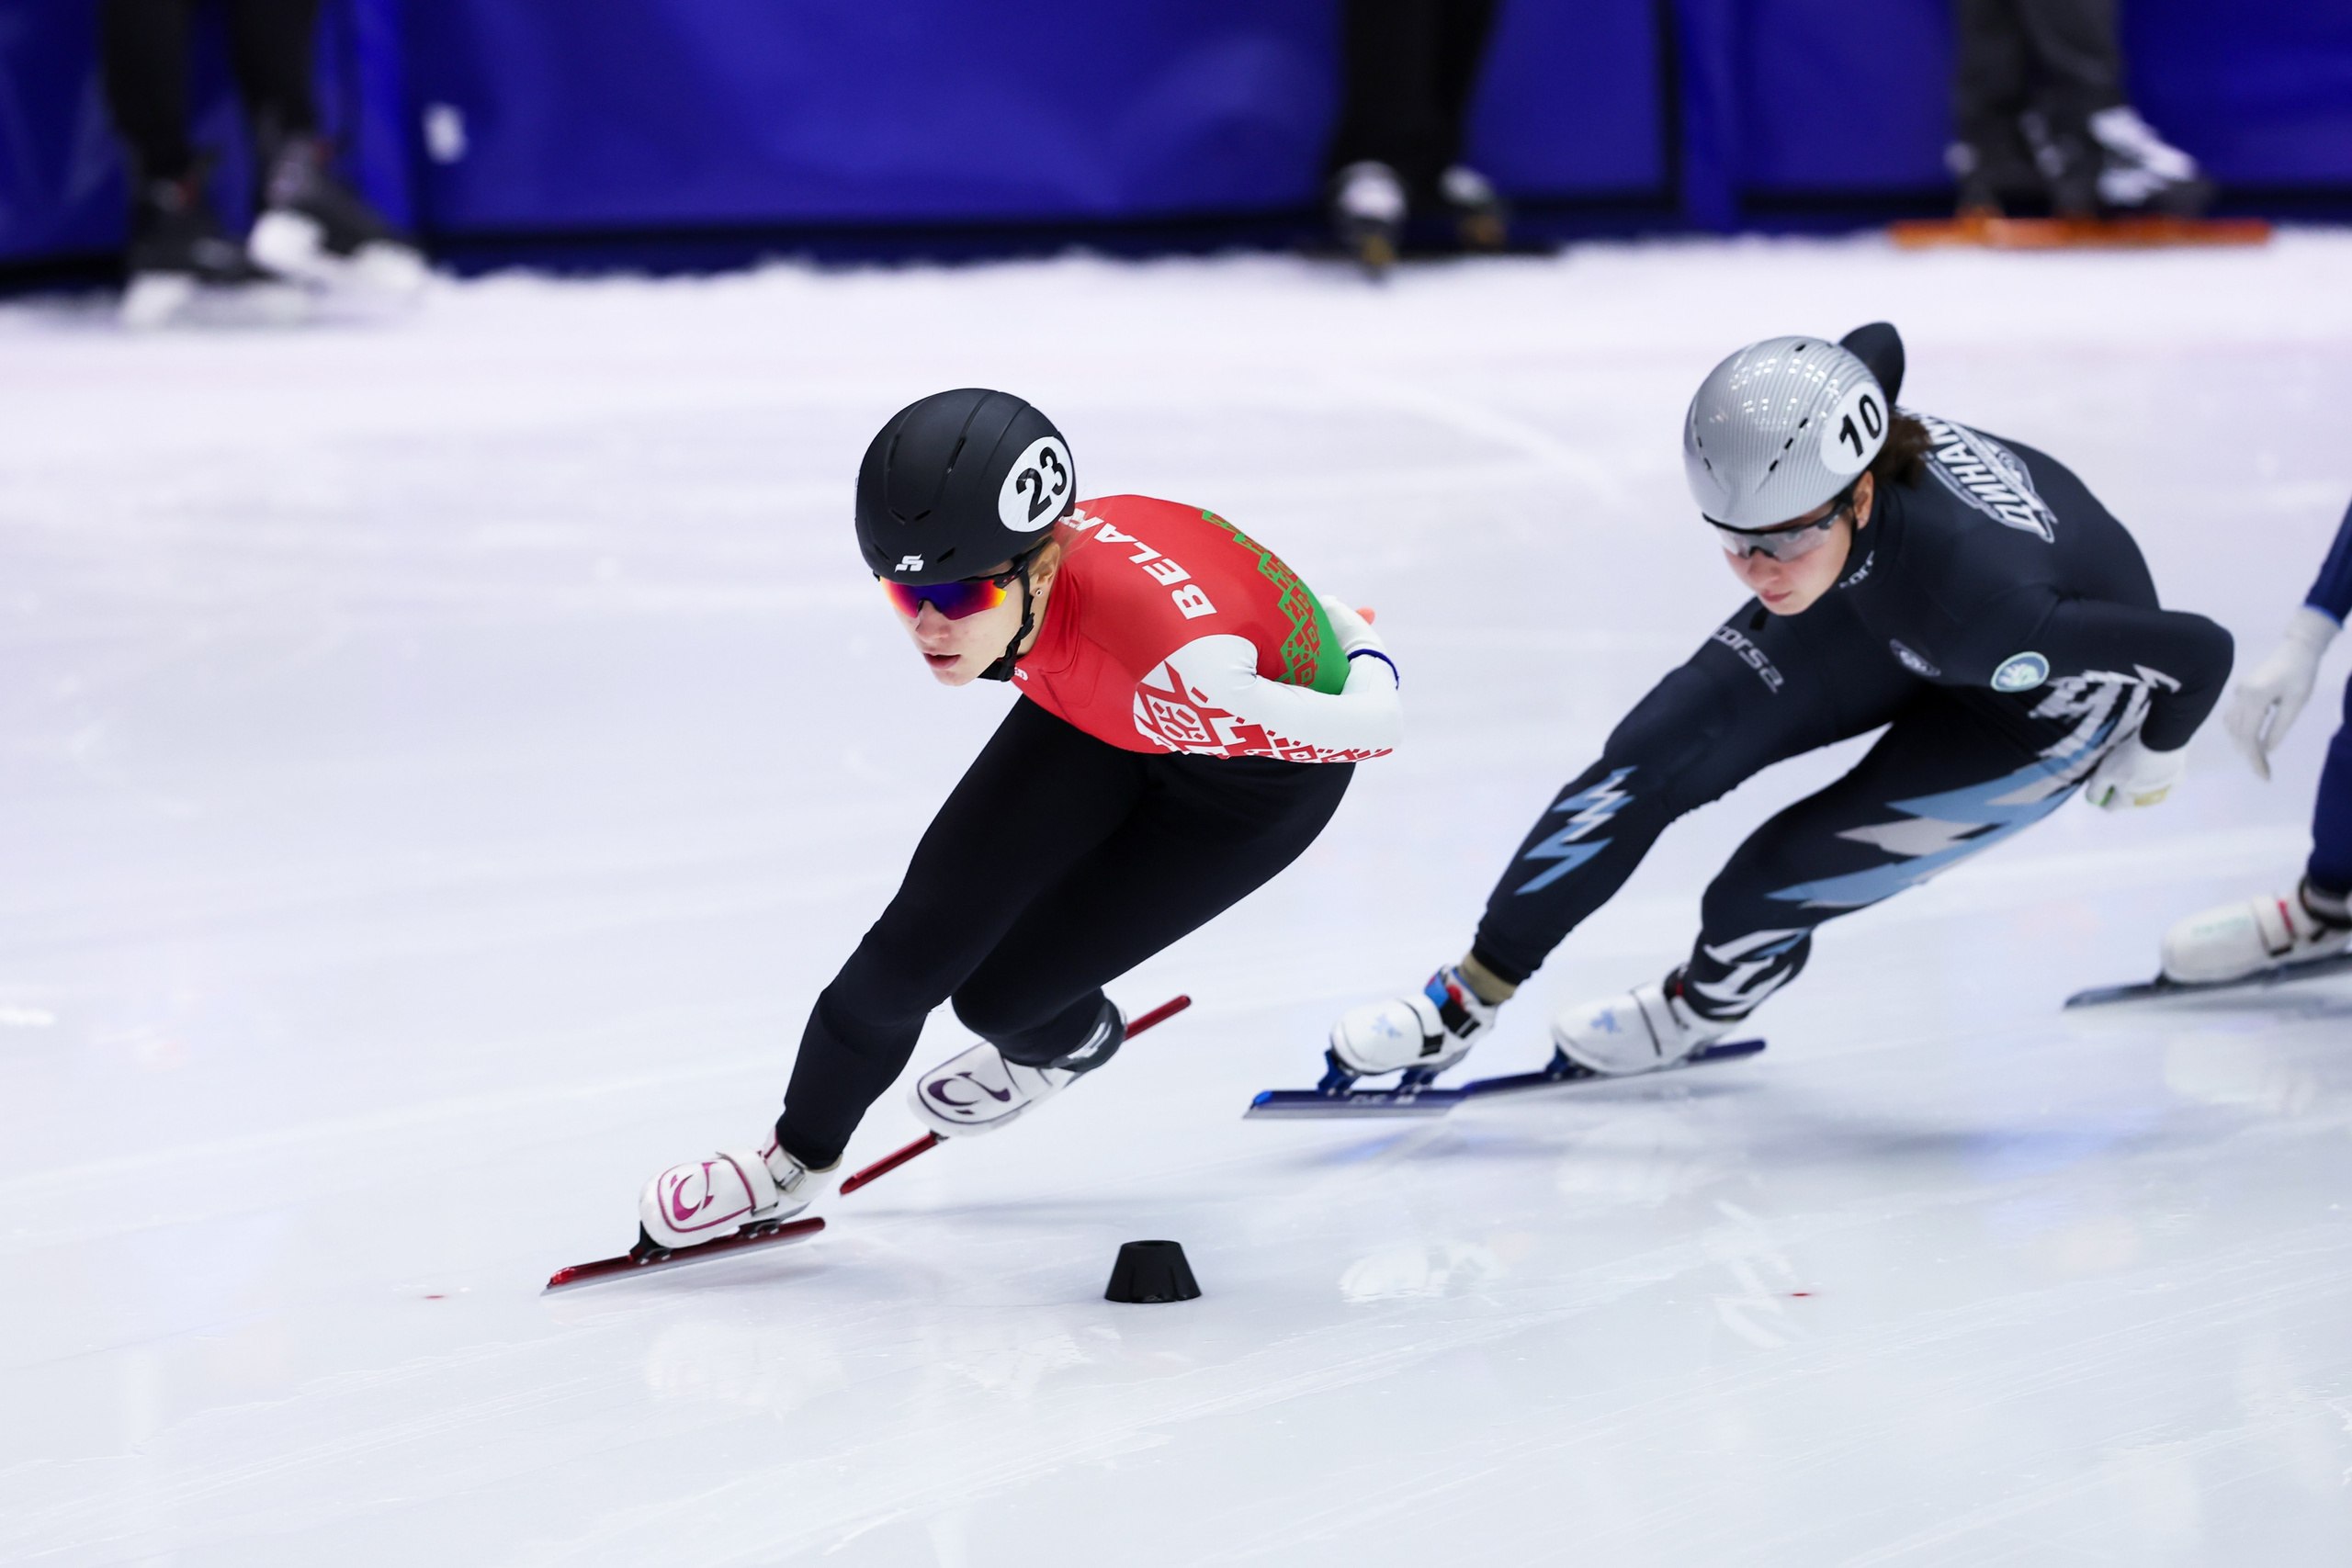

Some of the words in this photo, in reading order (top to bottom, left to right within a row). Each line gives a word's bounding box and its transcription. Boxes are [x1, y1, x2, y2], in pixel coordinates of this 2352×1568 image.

[1839, 394, 1882, 457] 10
[1015, 446, 1067, 524] 23
[1915, 412, 2048, 536] ДИНАМ
